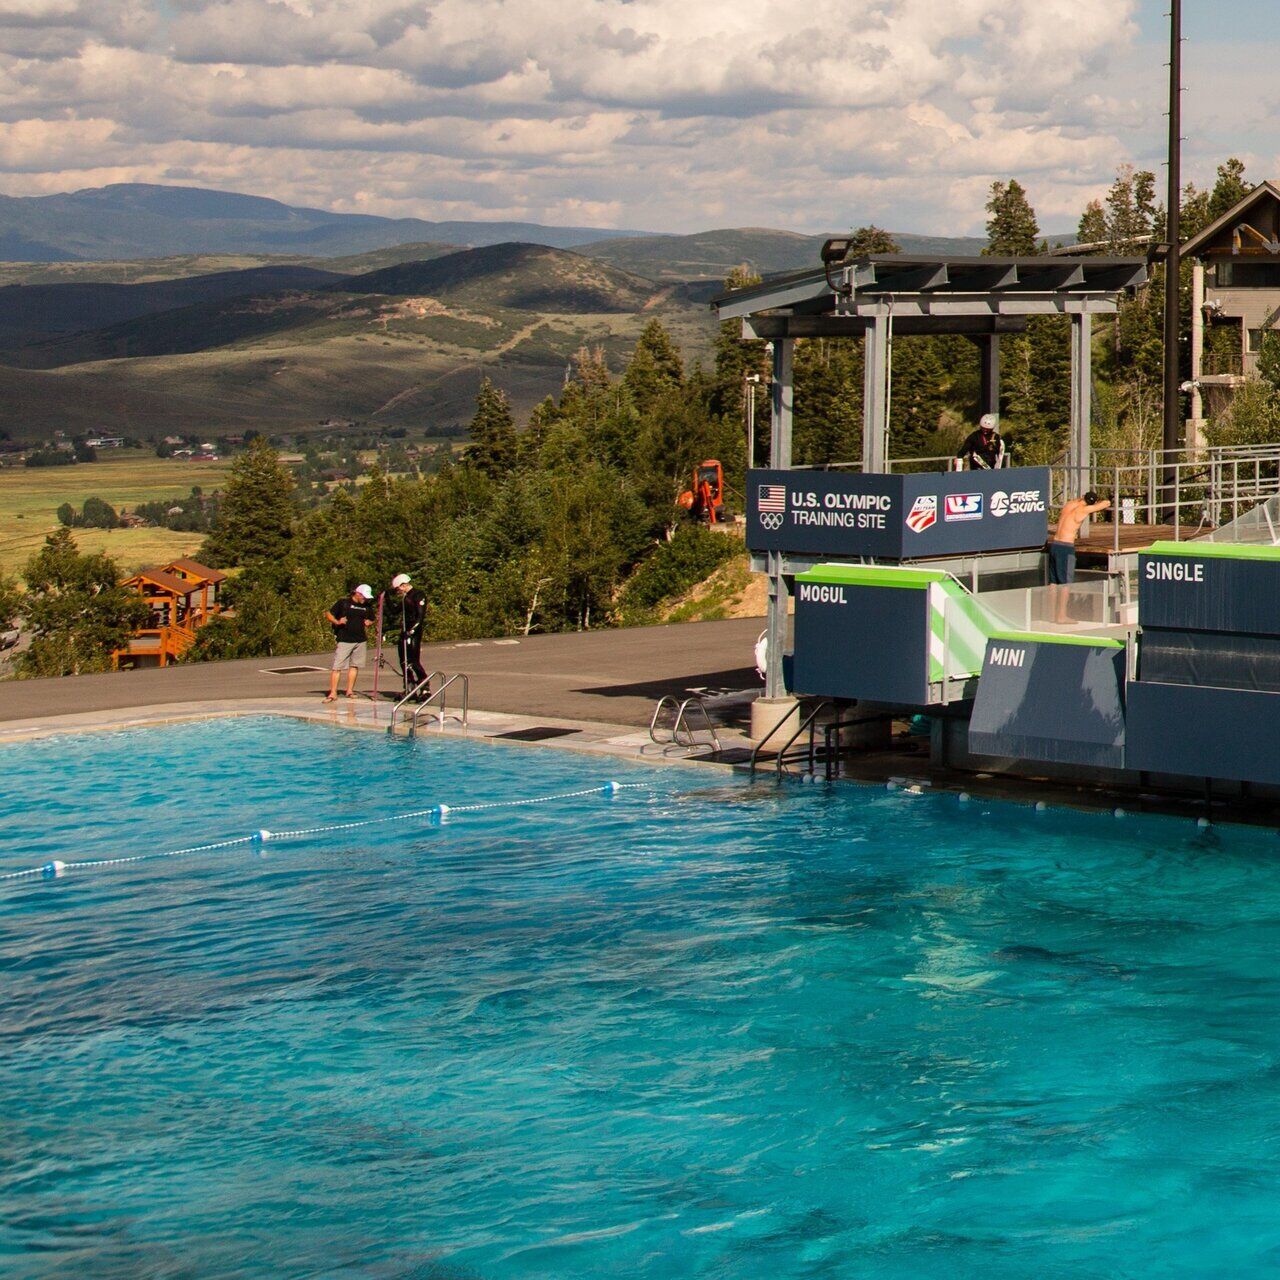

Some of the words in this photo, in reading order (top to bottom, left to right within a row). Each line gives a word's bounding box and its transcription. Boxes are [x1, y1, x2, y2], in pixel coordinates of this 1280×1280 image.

[791, 491, 821, 508] U.S.
[824, 493, 892, 511] OLYMPIC
[1010, 490, 1041, 502] FREE
[790, 509, 855, 528] TRAINING
[857, 512, 886, 529] SITE
[1145, 561, 1204, 582] SINGLE
[800, 584, 848, 604] MOGUL
[989, 647, 1026, 668] MINI
